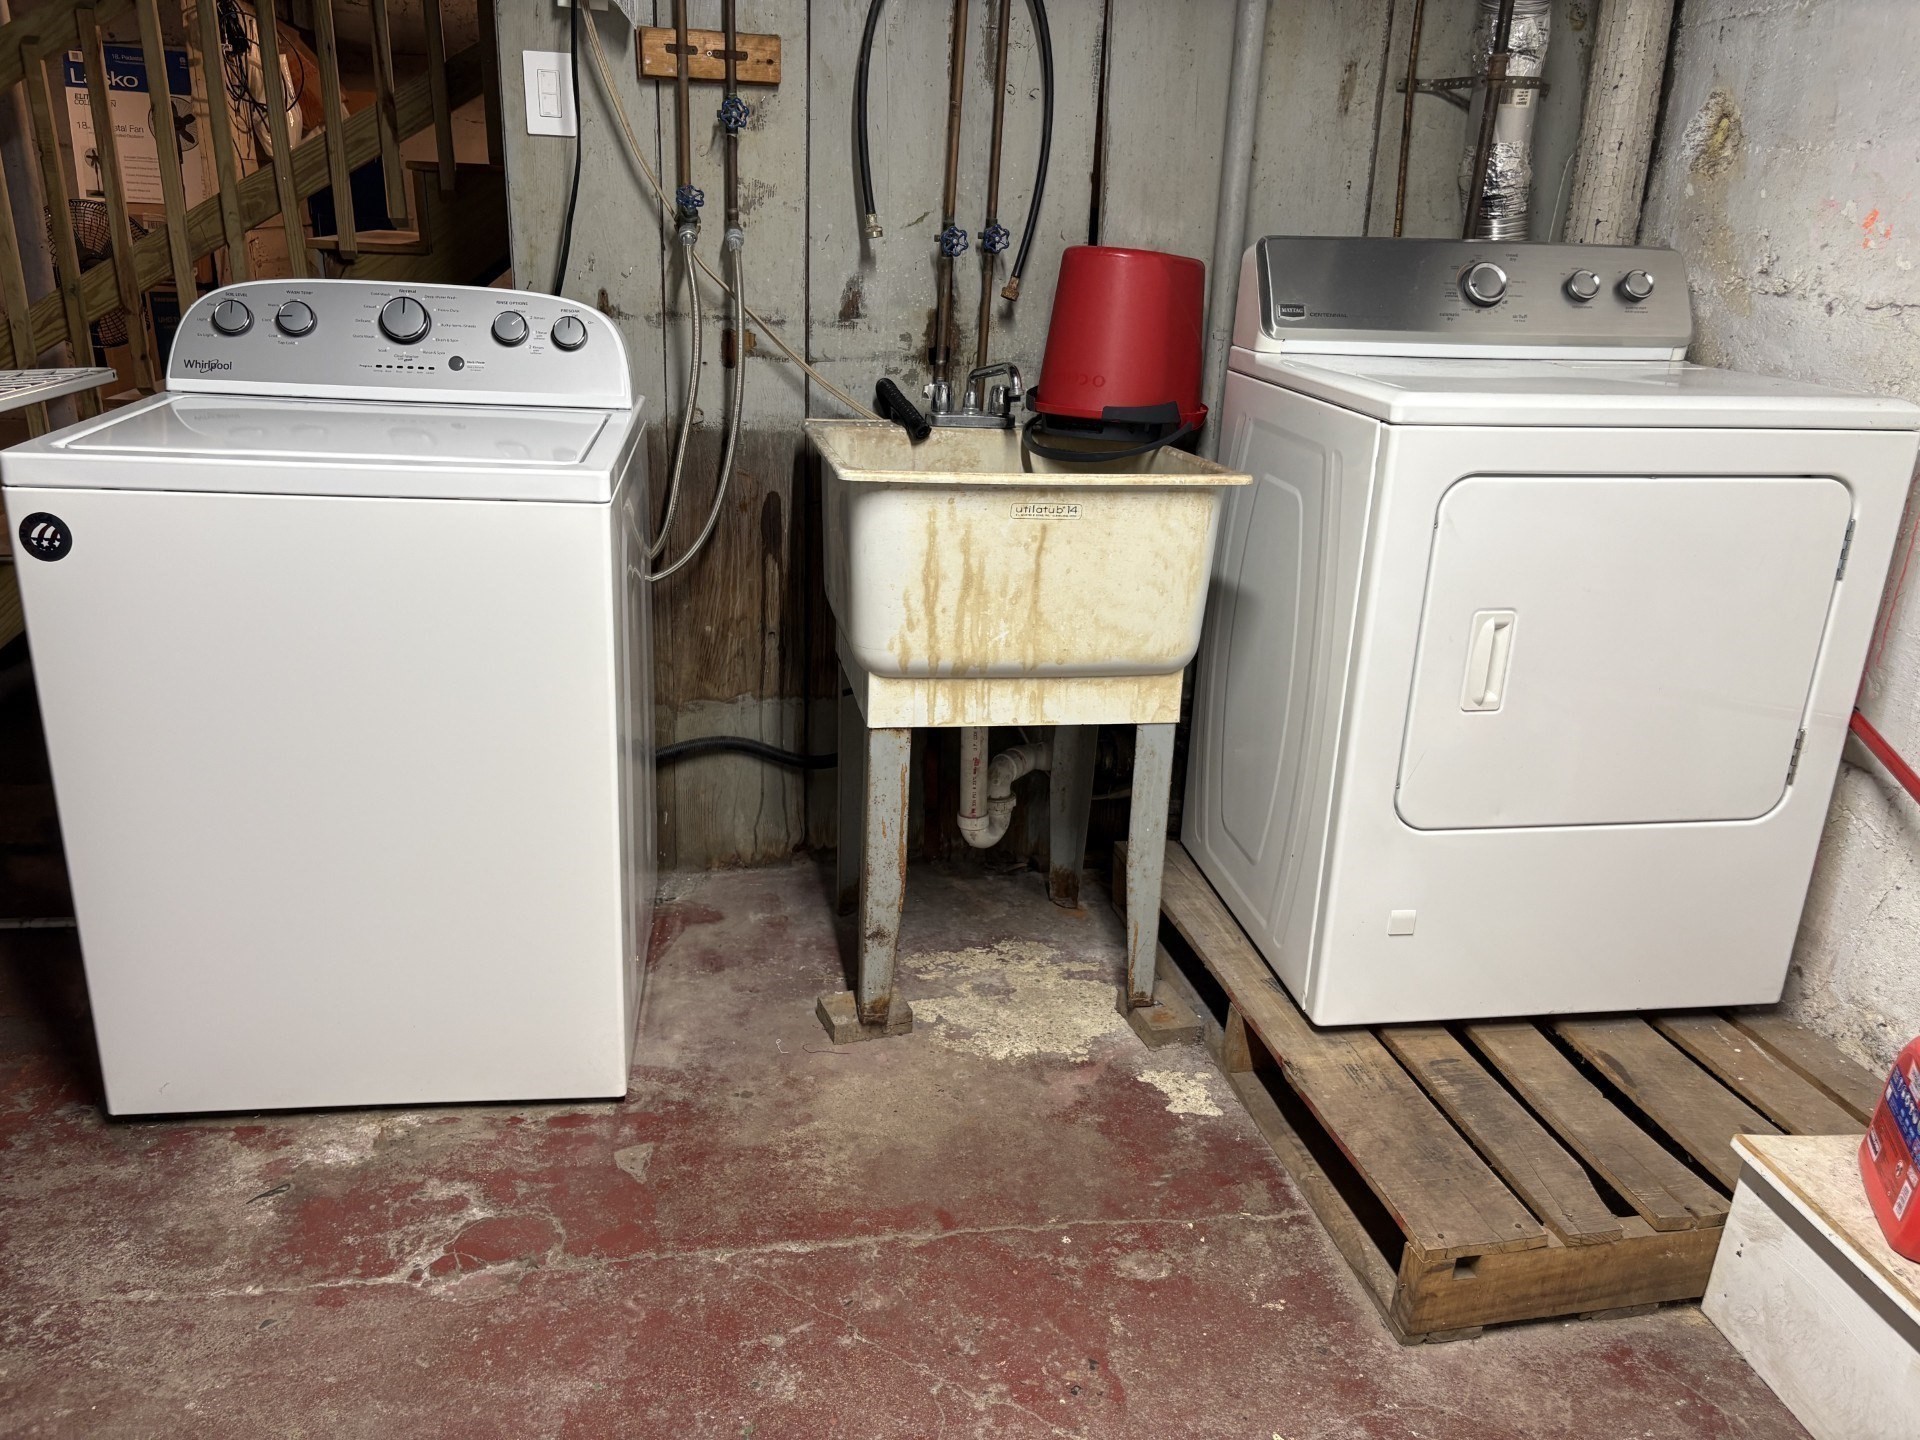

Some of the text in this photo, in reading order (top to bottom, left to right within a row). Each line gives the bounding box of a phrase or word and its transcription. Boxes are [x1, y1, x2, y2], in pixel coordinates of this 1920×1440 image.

[70, 67, 139, 88] Lsko
[129, 124, 144, 133] Fan
[183, 359, 232, 373] Whirlpool
[1067, 505, 1078, 514] 14
